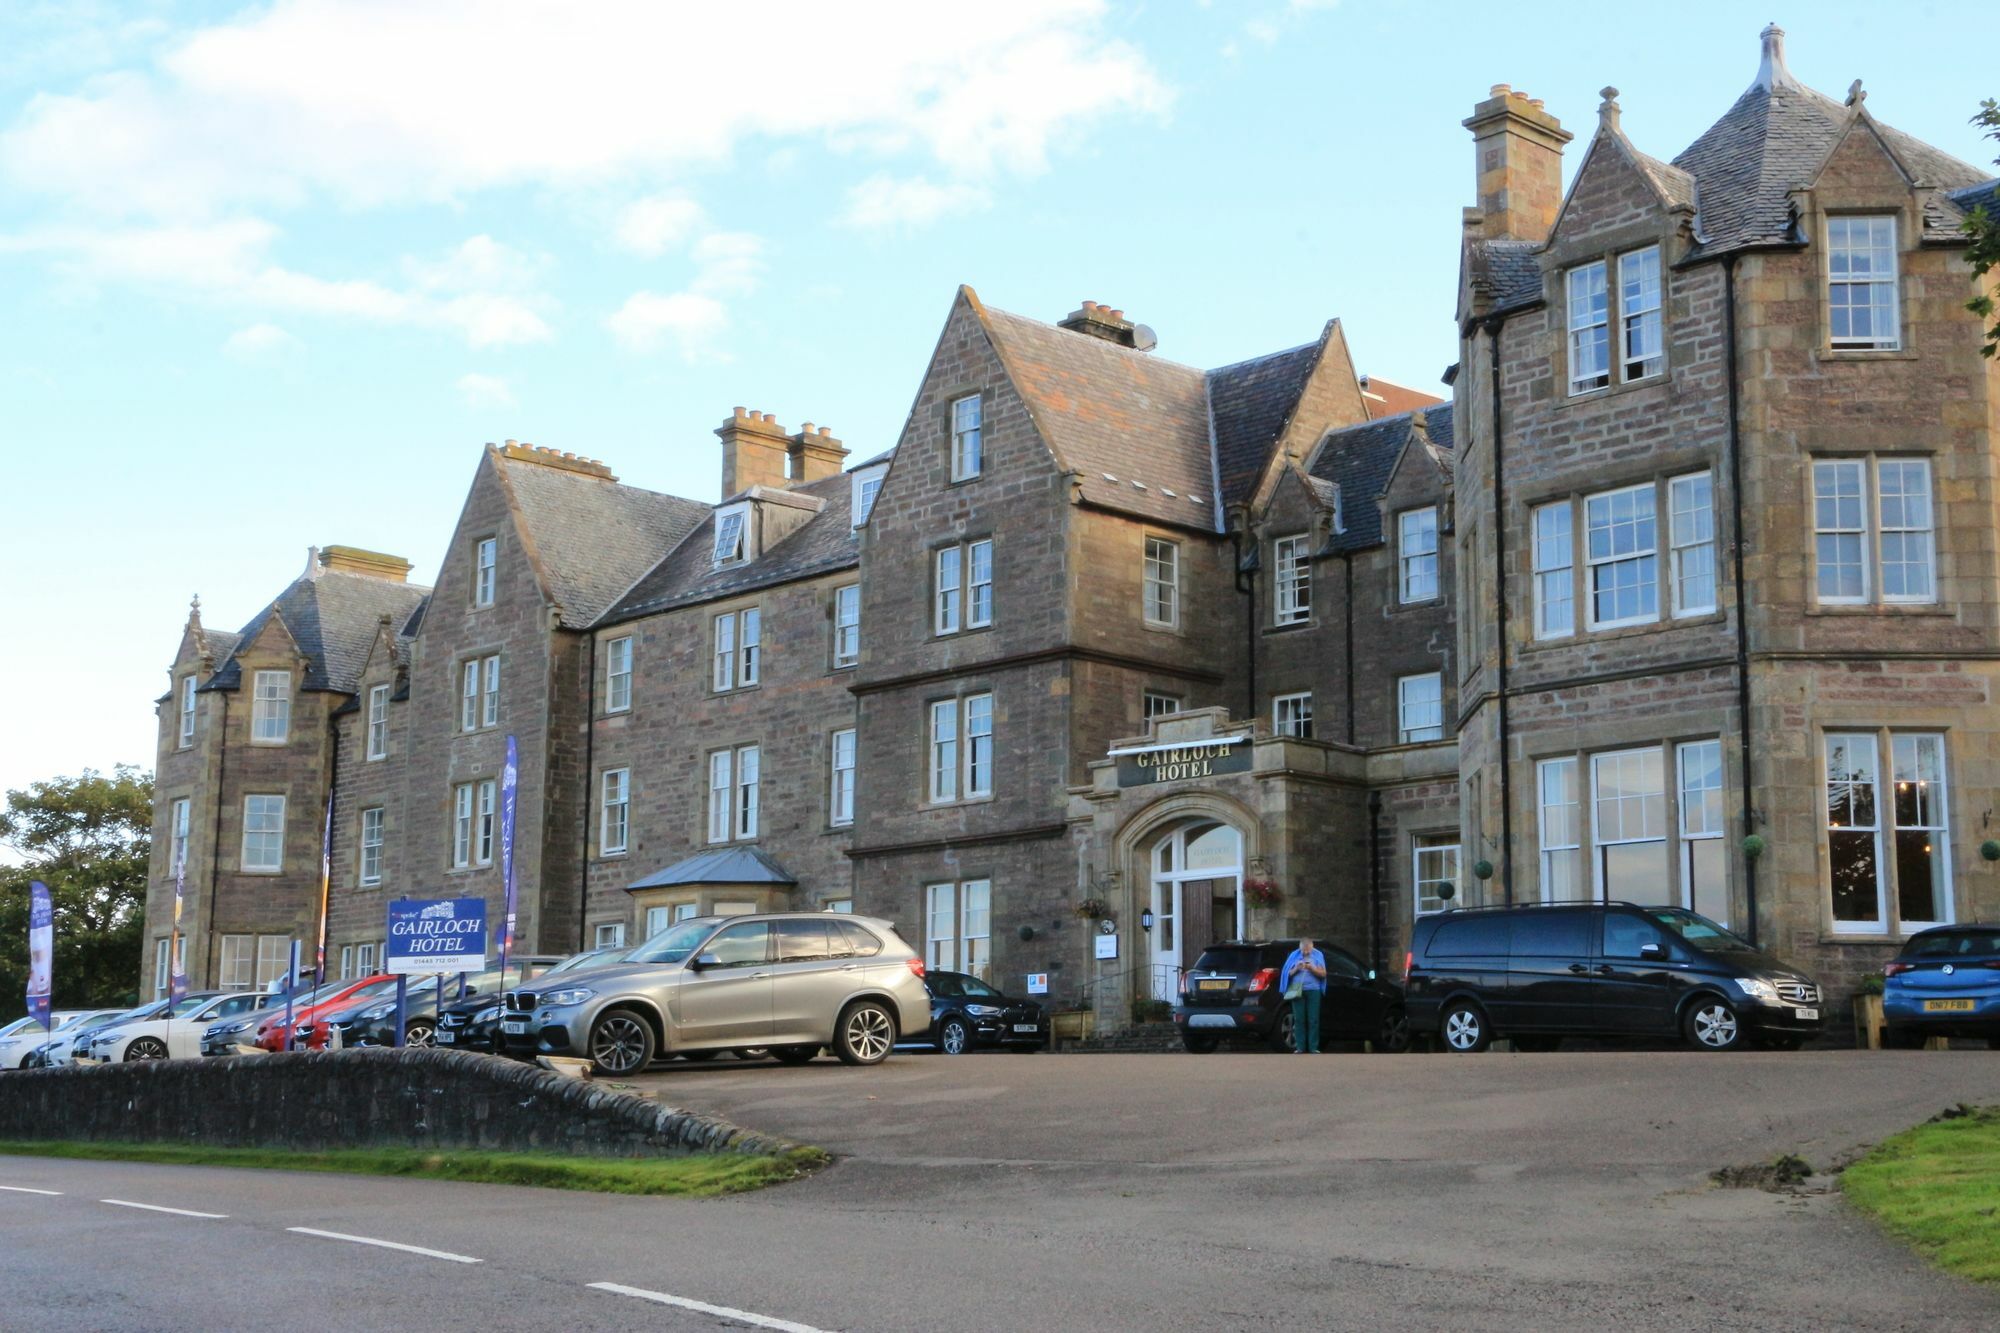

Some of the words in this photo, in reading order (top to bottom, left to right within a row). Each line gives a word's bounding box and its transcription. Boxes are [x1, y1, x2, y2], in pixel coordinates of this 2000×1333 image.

[1137, 744, 1231, 768] GAIRLOCH
[1156, 760, 1213, 782] HOTEL
[392, 919, 482, 938] GAIRLOCH
[408, 937, 466, 953] HOTEL
